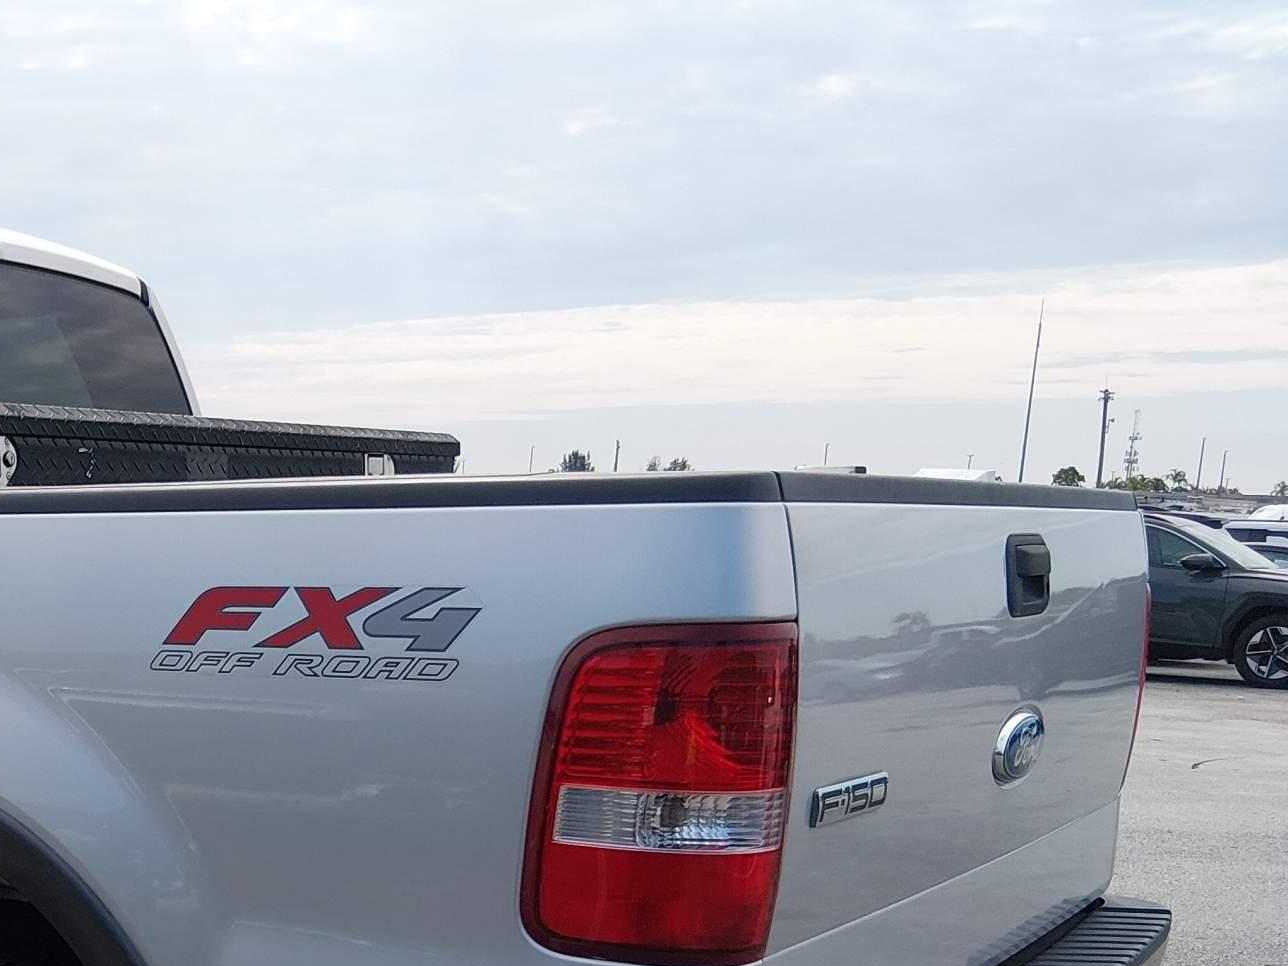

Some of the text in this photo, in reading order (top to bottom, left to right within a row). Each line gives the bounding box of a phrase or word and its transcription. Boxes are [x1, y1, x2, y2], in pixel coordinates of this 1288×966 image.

[162, 585, 483, 653] FX4
[149, 649, 461, 682] OFF ROAD
[816, 774, 890, 824] F-150
